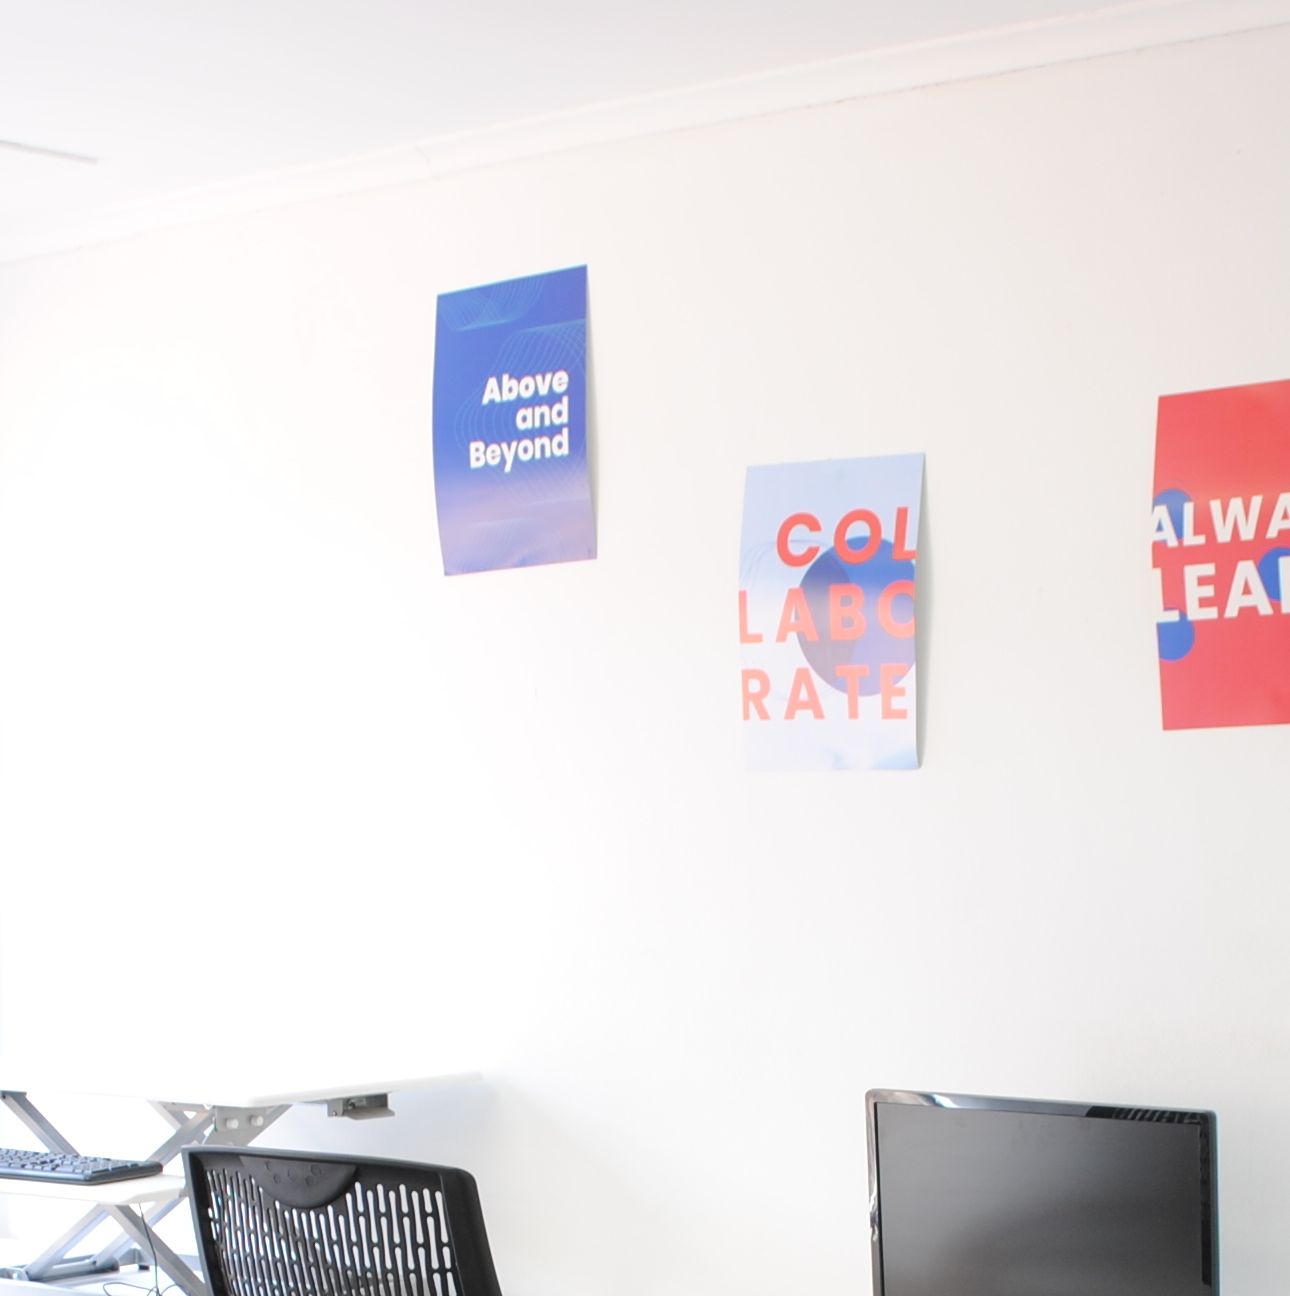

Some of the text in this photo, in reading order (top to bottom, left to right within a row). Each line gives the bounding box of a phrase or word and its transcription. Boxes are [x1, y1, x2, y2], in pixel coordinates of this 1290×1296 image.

[482, 369, 569, 406] Above
[516, 395, 569, 431] and
[470, 426, 569, 473] Beyond
[776, 506, 917, 568] COL
[741, 663, 908, 720] RATE
